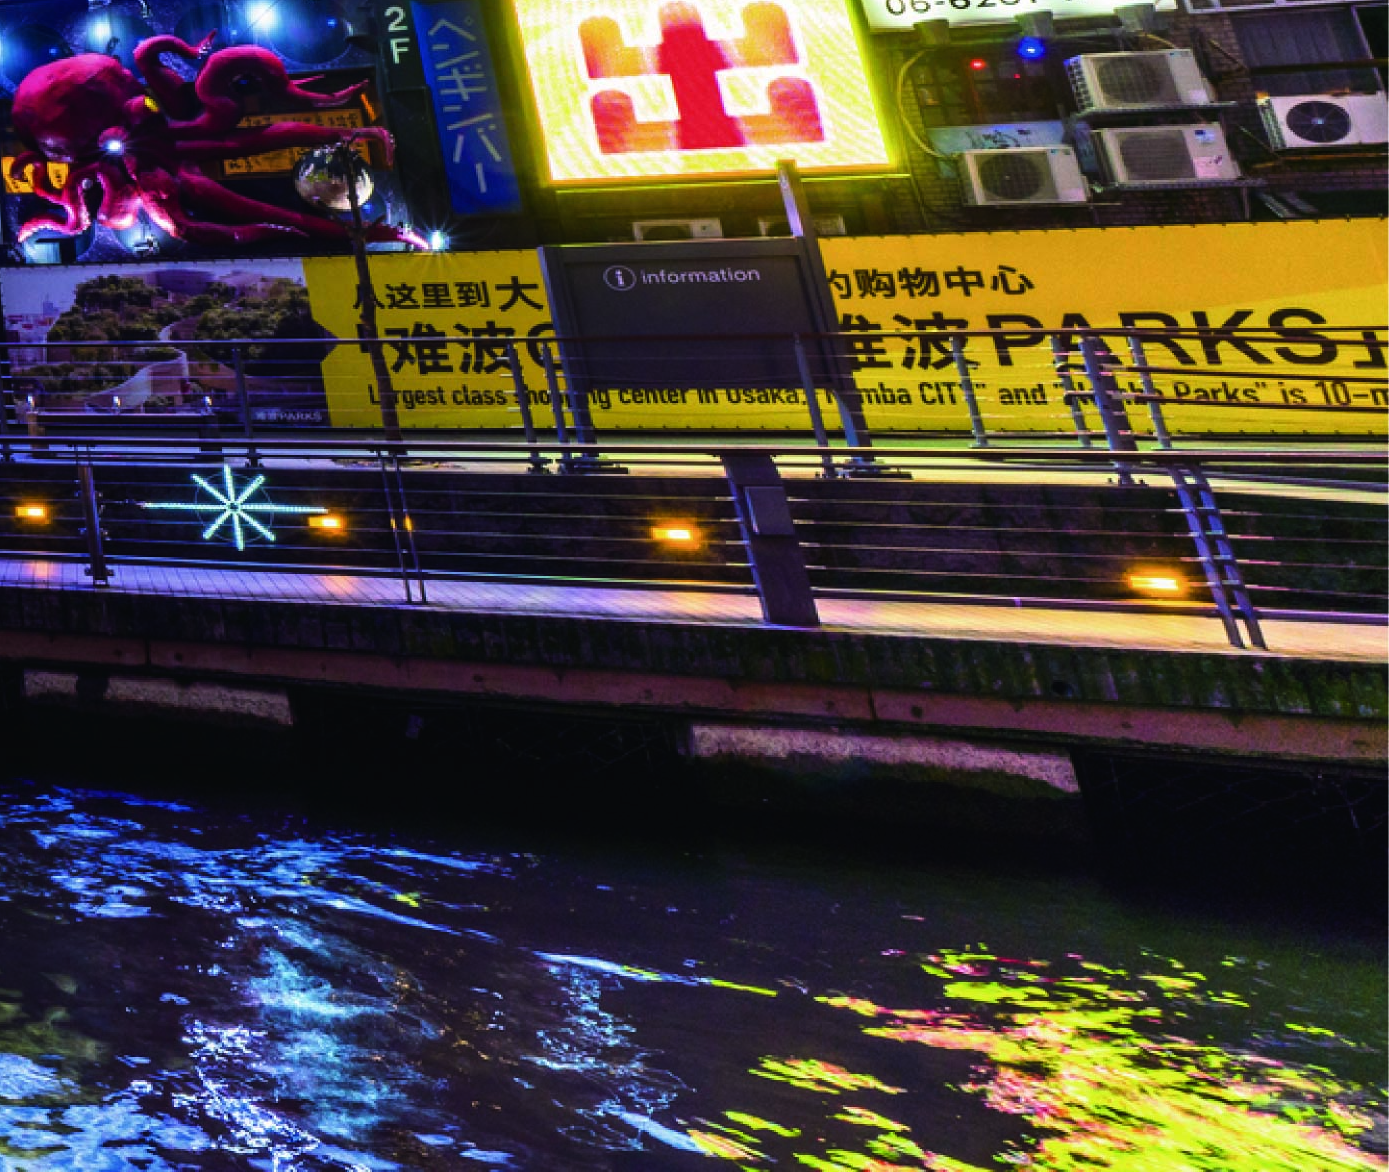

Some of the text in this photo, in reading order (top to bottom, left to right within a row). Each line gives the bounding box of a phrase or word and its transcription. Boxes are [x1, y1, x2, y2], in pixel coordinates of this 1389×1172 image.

[427, 15, 503, 194] ペンギンバー
[640, 265, 762, 285] information
[367, 385, 447, 410] Lrgest
[452, 384, 508, 406] class
[999, 382, 1048, 405] and
